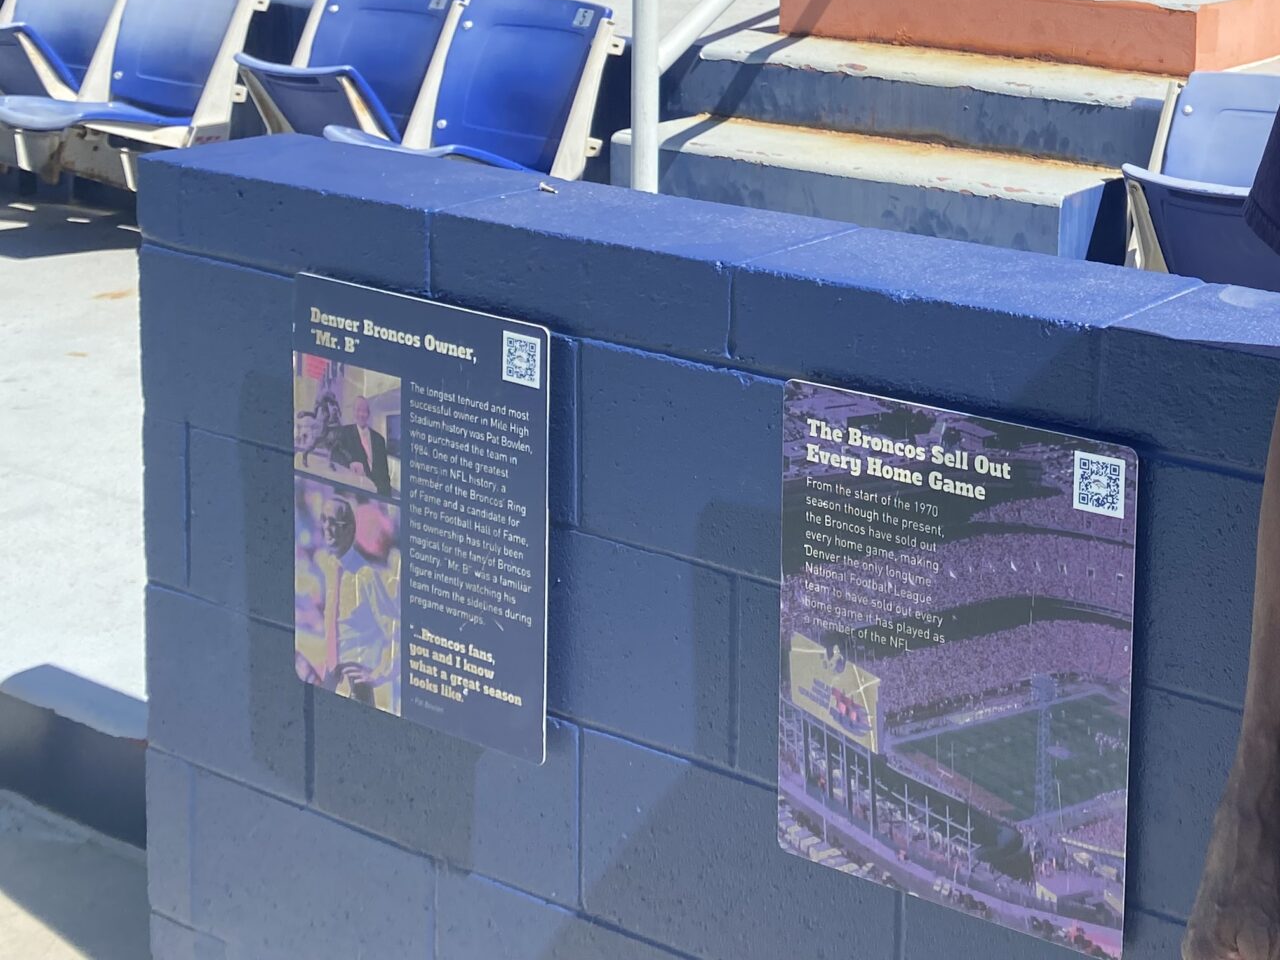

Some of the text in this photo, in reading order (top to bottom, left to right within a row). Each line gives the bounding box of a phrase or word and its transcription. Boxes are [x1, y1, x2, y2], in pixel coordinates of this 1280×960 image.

[310, 306, 476, 364] Denver Broncos Owner,
[410, 381, 529, 421] The longest tenured and most
[410, 398, 528, 439] successful owner in Mile High
[409, 412, 532, 454] Stadium history was Pat Bowlen,
[409, 428, 517, 465] who purchased the team in
[806, 418, 1011, 480] The Broncos Sell Out
[409, 460, 438, 474] owners
[440, 468, 447, 476] in
[449, 468, 466, 482] NFL
[432, 448, 447, 462] One
[450, 453, 457, 464] of
[460, 456, 472, 468] the
[475, 461, 508, 480] greatest
[806, 443, 986, 501] Every Home Game
[409, 474, 442, 491] member
[444, 483, 452, 493] of
[454, 486, 467, 497] the
[507, 499, 526, 517] Ring
[409, 487, 417, 499] of
[419, 490, 440, 505] Fame
[443, 497, 457, 510] and
[466, 505, 505, 524] candidate
[508, 516, 519, 528] for
[806, 476, 938, 517] From the start of the 1970
[409, 503, 528, 547] the Pro Football Hall of Fame,
[805, 496, 944, 538] season though the present,
[805, 511, 935, 552] the Broncos have sold out
[409, 519, 523, 559] his ownership has truly been
[409, 533, 530, 578] magical for the fans of Broncos
[805, 530, 938, 574] every home game, making
[409, 563, 515, 604] figure intently watching his
[474, 570, 490, 580] was
[499, 575, 531, 594] familiar
[803, 544, 931, 589] Denver the only longtime
[805, 561, 931, 607] National Football League
[409, 578, 531, 627] team from the sidelines during
[409, 595, 443, 614] pregame
[804, 580, 943, 628] team to have sold out every
[804, 596, 944, 644] home game it has played as
[813, 616, 853, 636] member
[858, 627, 867, 639] of
[870, 631, 886, 645] the
[409, 643, 429, 660] you
[432, 648, 452, 666] and
[463, 658, 494, 679] know
[468, 643, 495, 666] fans,
[409, 656, 437, 677] what
[450, 673, 480, 693] great
[483, 684, 521, 706] season
[409, 672, 437, 693] looks
